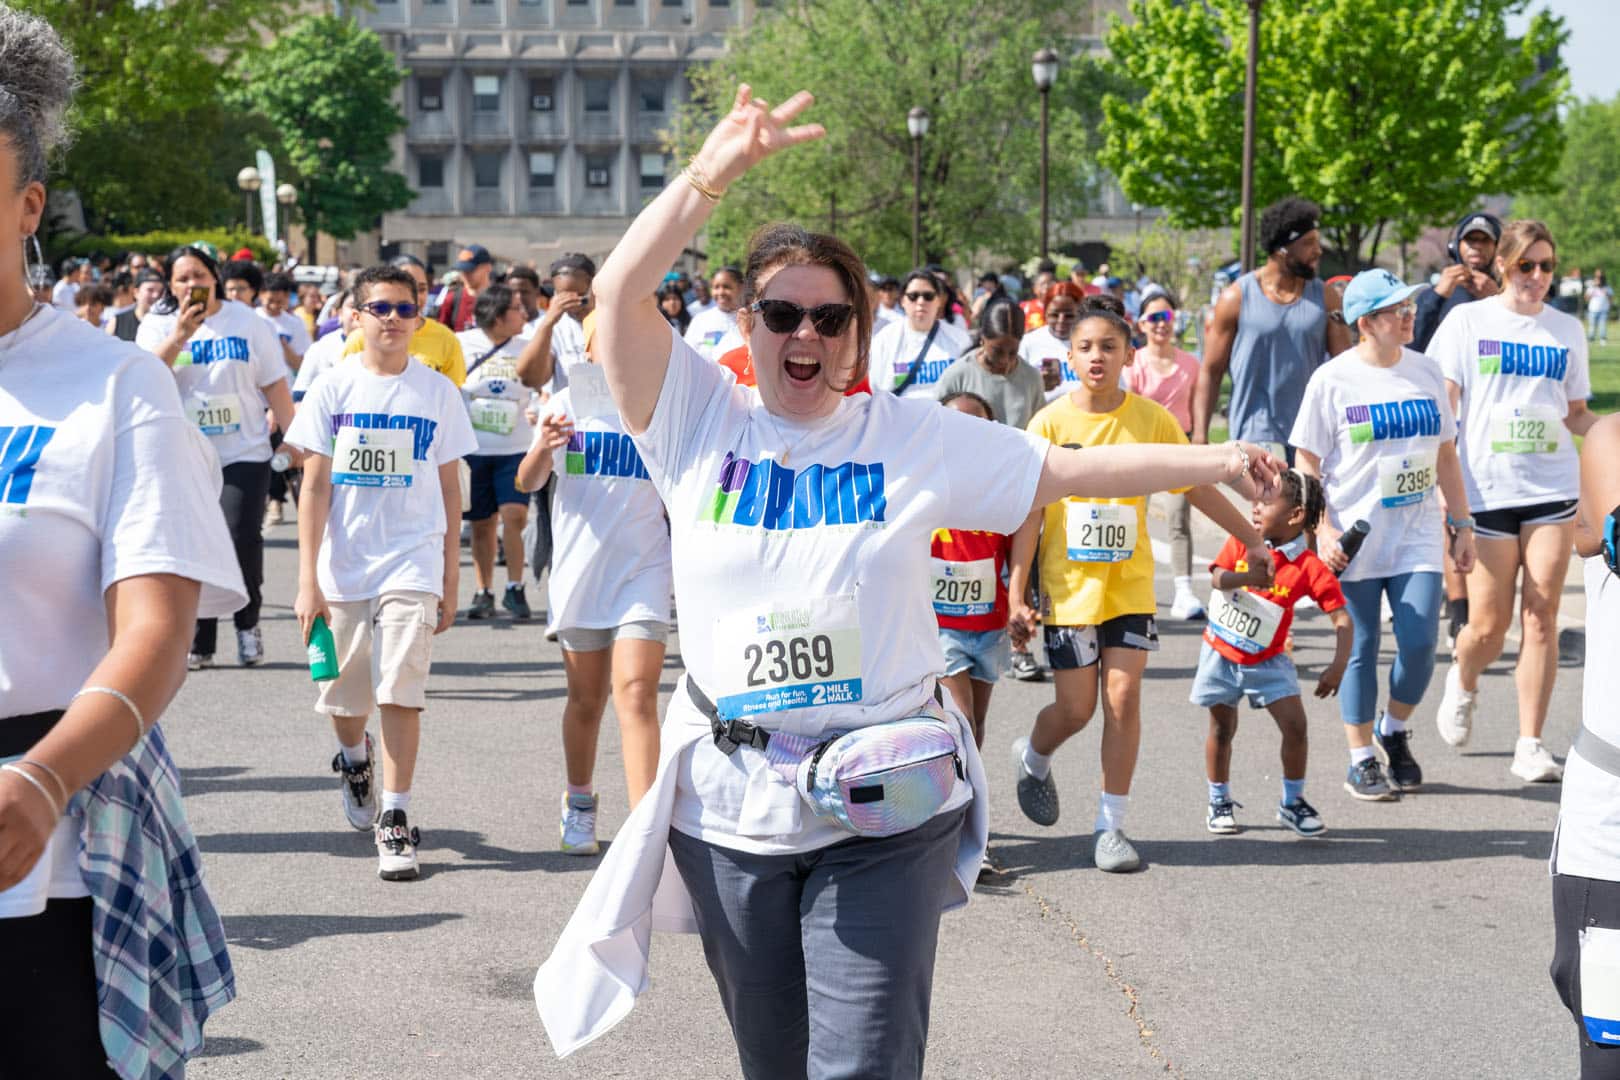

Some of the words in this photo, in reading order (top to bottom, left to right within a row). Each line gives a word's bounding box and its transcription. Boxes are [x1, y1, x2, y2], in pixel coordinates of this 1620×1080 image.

[1501, 341, 1569, 381] BRONX
[196, 407, 231, 426] 2110
[1345, 405, 1370, 425] RUN
[1508, 420, 1546, 440] 1222
[348, 448, 396, 472] 2061
[1396, 467, 1431, 494] 2395
[733, 459, 888, 531] BRONX
[1081, 523, 1126, 548] 2109
[935, 578, 982, 602] 2079
[1218, 603, 1262, 638] 2080
[744, 634, 834, 687] 2369
[765, 692, 780, 702] Run
[780, 691, 792, 699] for
[811, 684, 827, 705] 2
[826, 683, 850, 694] MILE
[827, 692, 853, 704] WALK
[742, 703, 767, 713] fitness
[767, 700, 782, 709] and
[782, 696, 808, 706] health!
